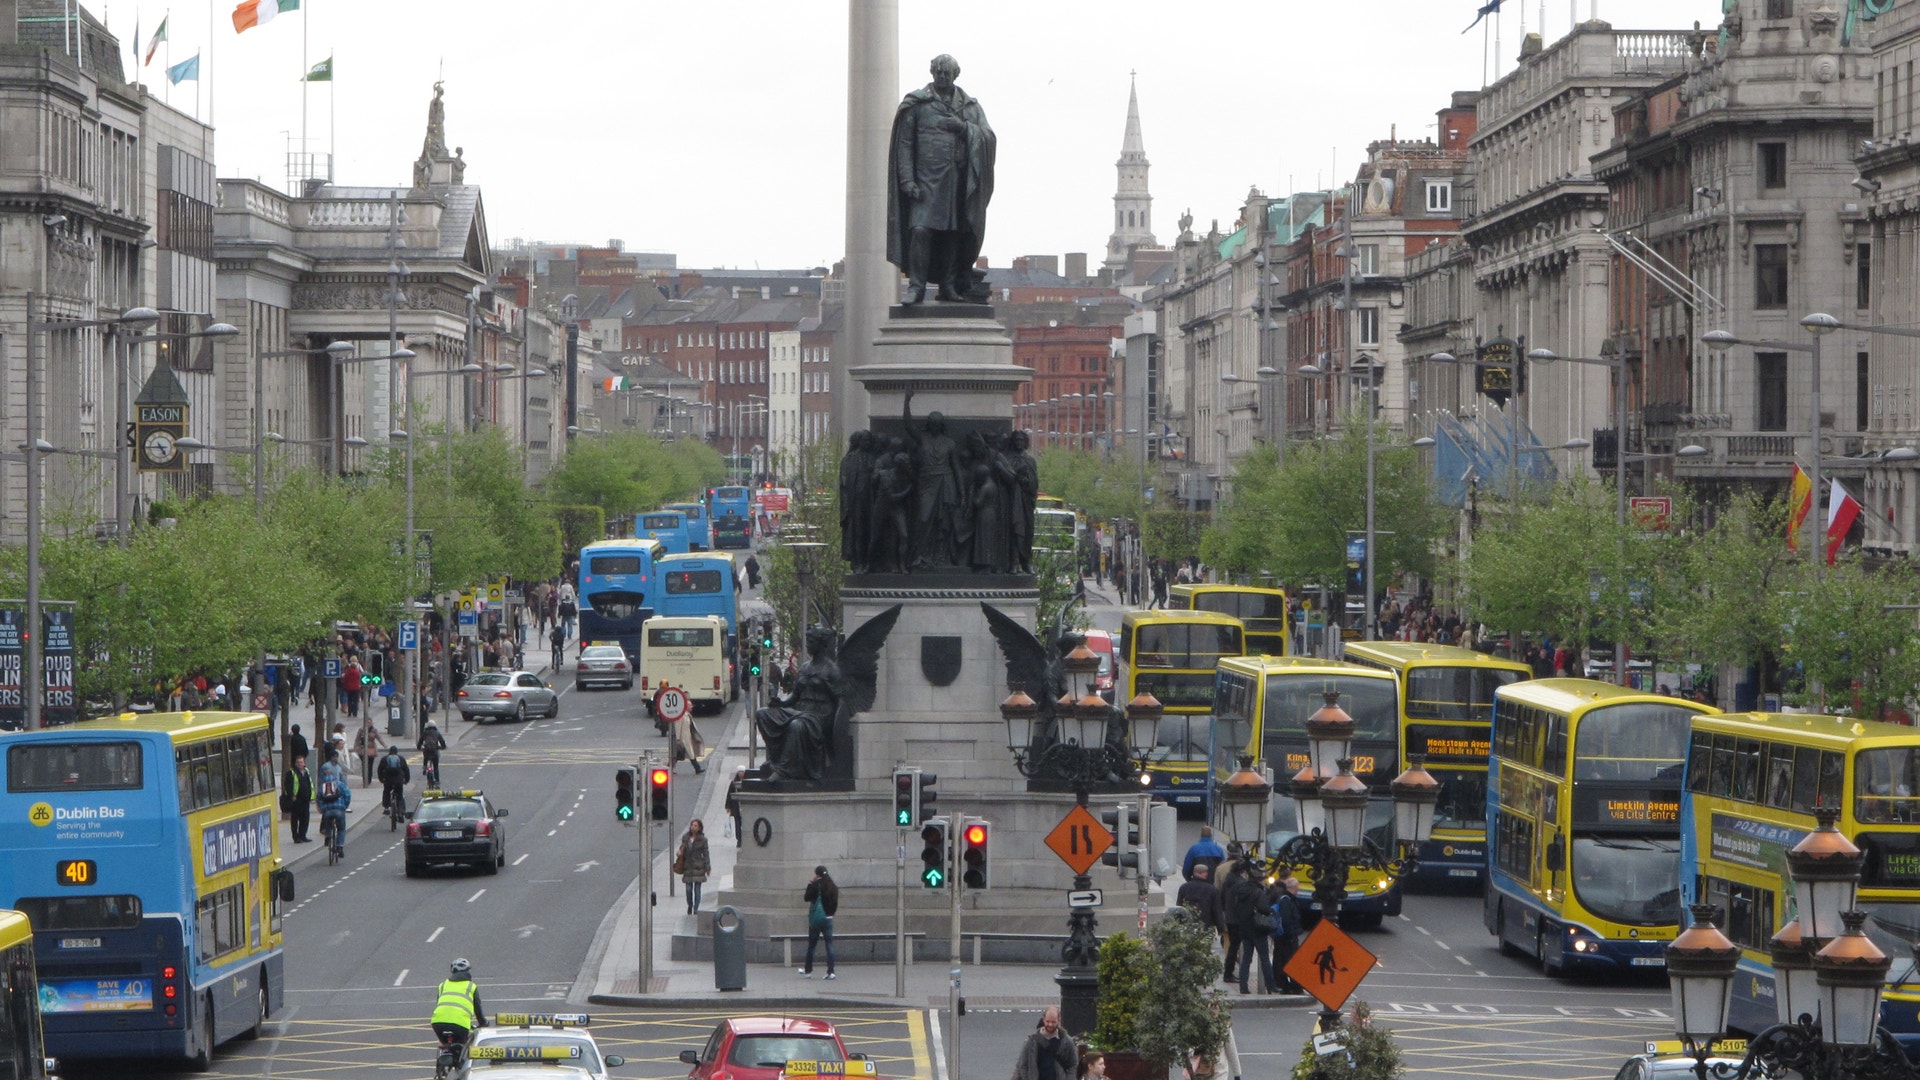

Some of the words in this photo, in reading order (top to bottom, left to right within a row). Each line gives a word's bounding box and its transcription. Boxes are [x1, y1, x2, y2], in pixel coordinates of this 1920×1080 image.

[621, 356, 650, 366] GATE
[142, 408, 180, 421] EASON
[402, 631, 415, 647] P
[46, 656, 72, 671] DUB
[326, 661, 336, 675] P
[46, 670, 73, 687] LIN
[47, 690, 73, 707] ERS
[665, 693, 678, 708] 30
[1427, 739, 1469, 747] Monkstown
[1287, 753, 1310, 762] Kilna
[1353, 756, 1374, 772] 123
[1608, 800, 1645, 810] Limekiln
[1647, 801, 1679, 811] Avenue
[56, 808, 97, 819] Dublin
[99, 806, 125, 818] Bus
[1611, 811, 1624, 819] via
[1626, 810, 1644, 819] City
[1646, 811, 1676, 820] Centre
[56, 822, 86, 830] Serving
[88, 821, 101, 829] the
[80, 831, 125, 840] community
[219, 829, 238, 865] Tune
[239, 823, 248, 859] in
[248, 823, 257, 857] to
[1888, 854, 1920, 864] Liffe
[66, 861, 87, 882] 40
[97, 981, 119, 989] SAVE
[530, 1015, 556, 1025] TAXI
[480, 1048, 504, 1058] 25549
[508, 1048, 539, 1058] TAXI
[570, 1048, 578, 1057] D
[1648, 1043, 1655, 1052] D
[793, 1062, 817, 1072] 33326
[819, 1062, 844, 1073] TAXI
[865, 1062, 874, 1072] D
